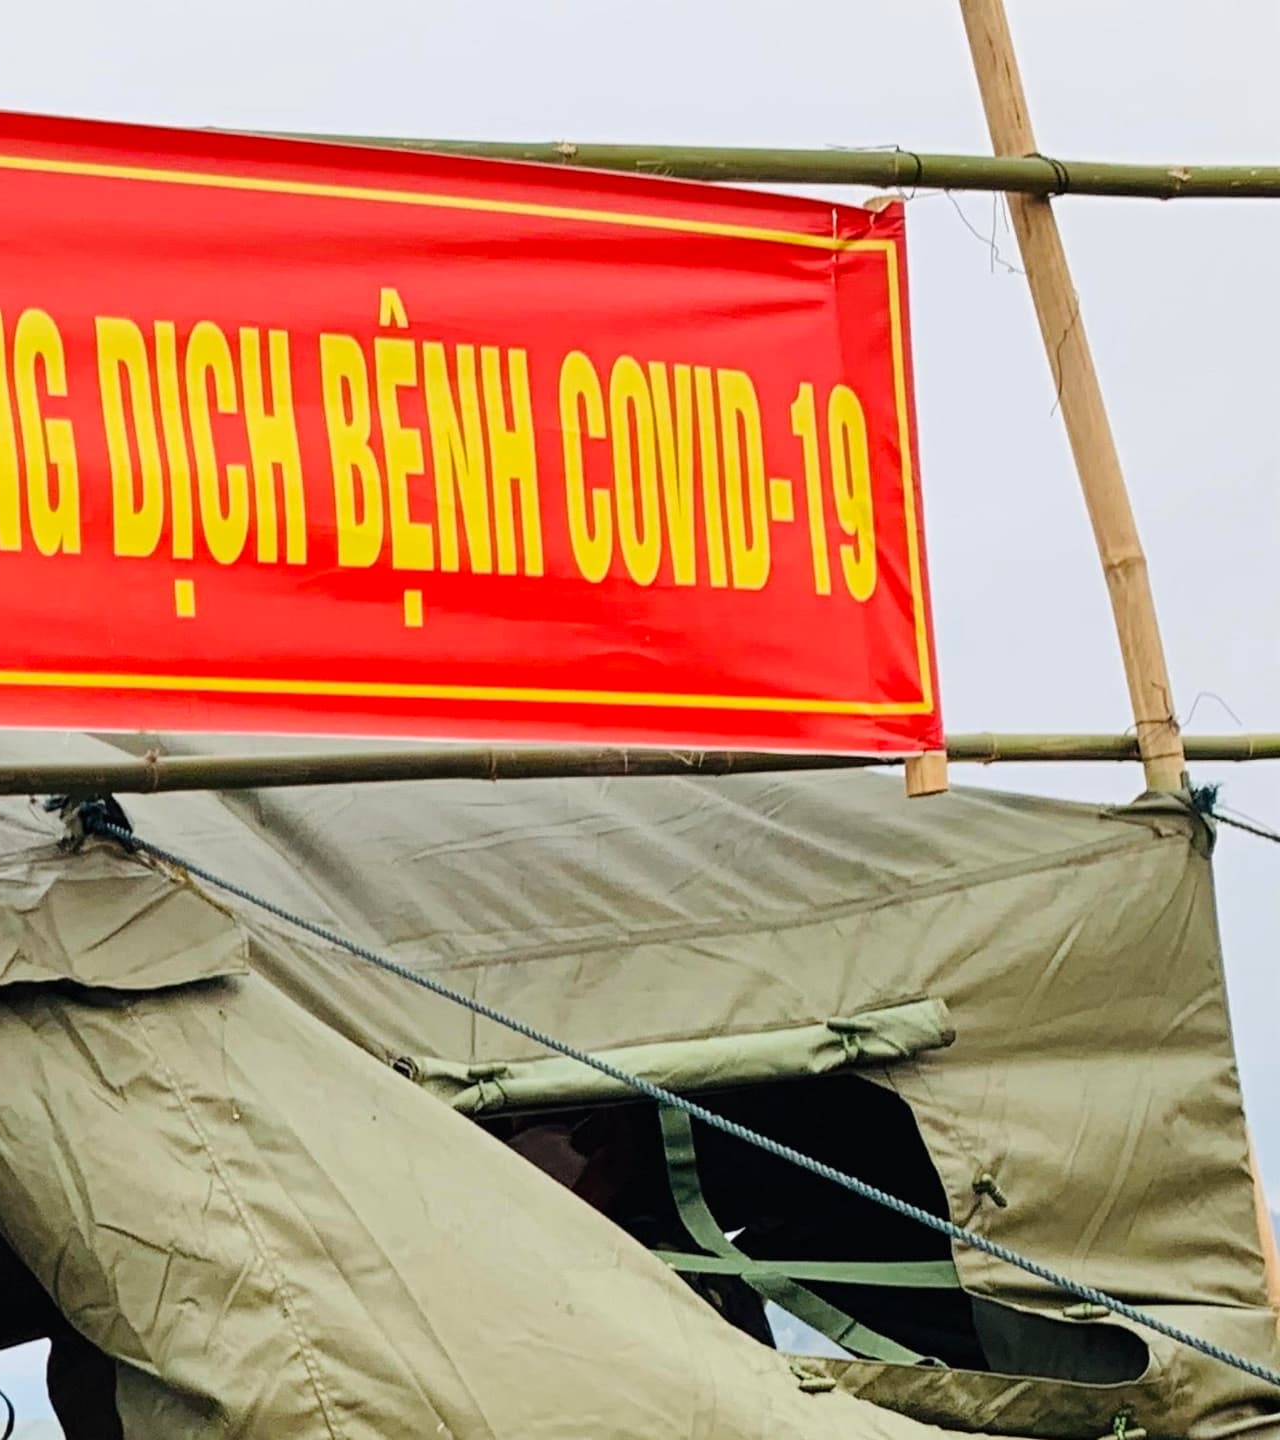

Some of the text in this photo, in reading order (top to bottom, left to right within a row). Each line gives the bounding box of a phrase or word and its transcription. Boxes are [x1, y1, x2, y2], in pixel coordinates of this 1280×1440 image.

[95, 316, 307, 618] DỊCH
[319, 287, 544, 628] BỆNH
[558, 350, 877, 603] COVID-19
